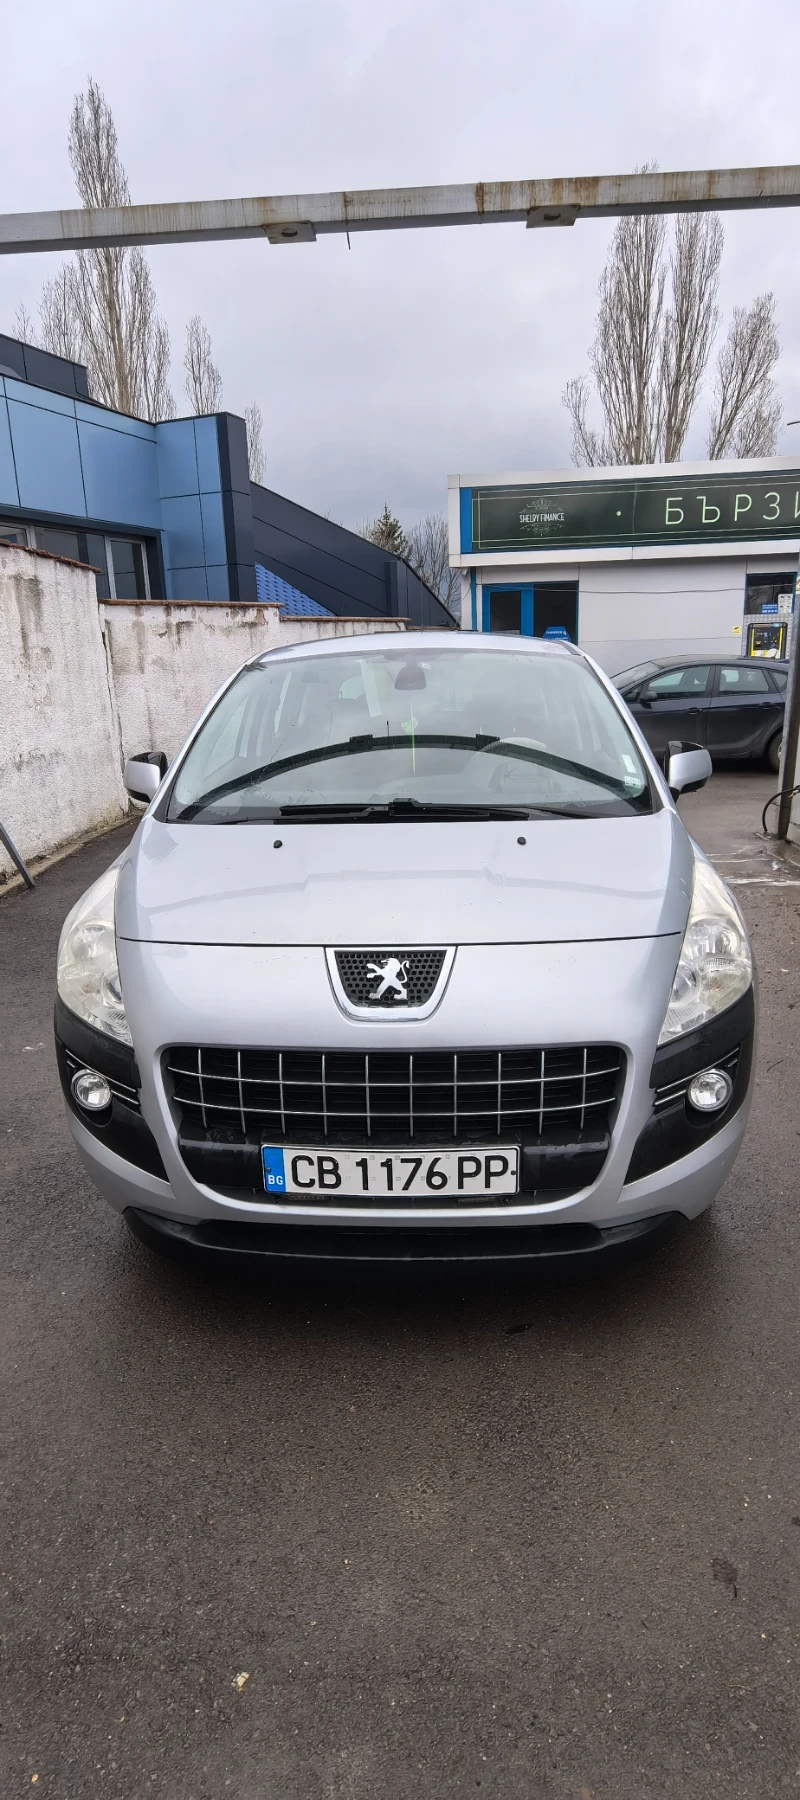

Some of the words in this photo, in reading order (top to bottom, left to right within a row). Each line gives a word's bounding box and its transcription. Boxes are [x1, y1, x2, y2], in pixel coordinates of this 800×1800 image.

[540, 513, 565, 522] FINANCE
[291, 1154, 342, 1189] CB
[355, 1157, 448, 1191] 1176
[457, 1155, 509, 1190] PP
[267, 1174, 284, 1185] BG
